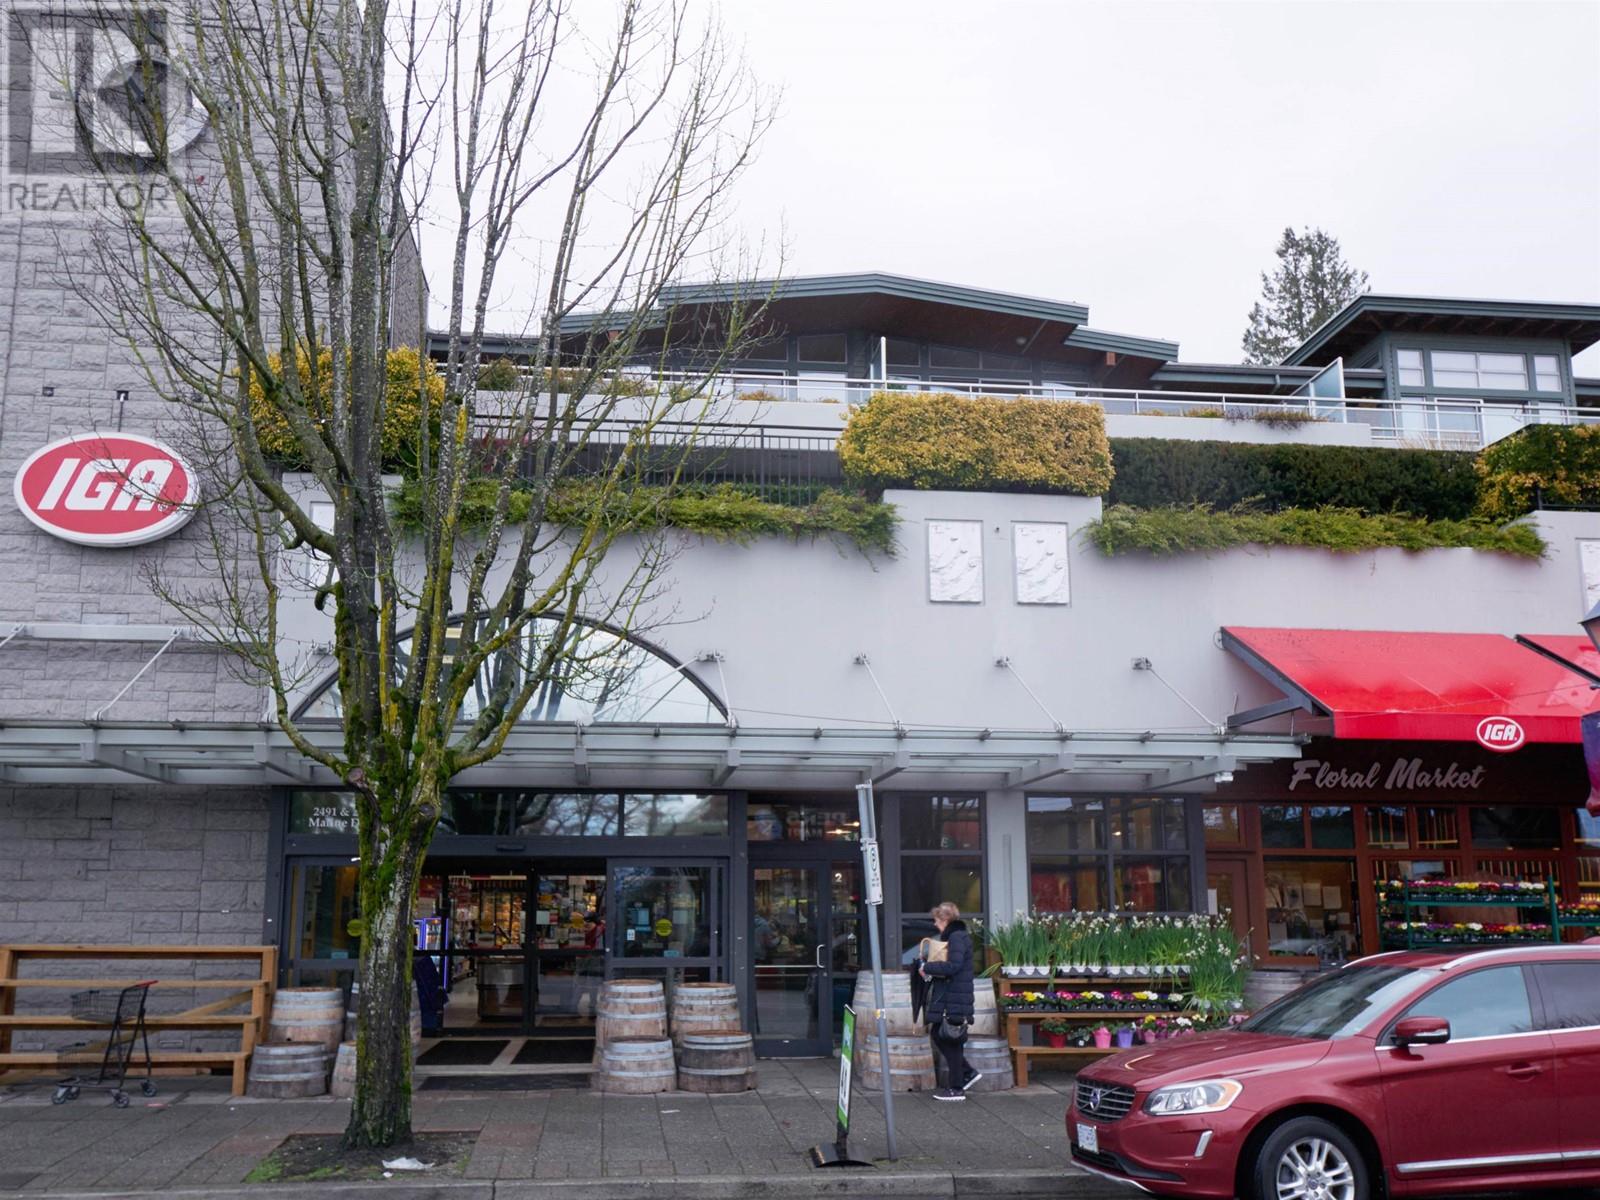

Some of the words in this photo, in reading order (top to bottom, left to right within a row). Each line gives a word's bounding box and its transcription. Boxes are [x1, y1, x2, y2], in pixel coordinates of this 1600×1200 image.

[37, 457, 174, 511] IGA
[1484, 724, 1516, 741] IGA
[1289, 759, 1381, 791] Floral
[1384, 757, 1486, 790] Market
[313, 807, 337, 817] 2491
[340, 807, 350, 817] &
[308, 817, 348, 828] Marine
[834, 872, 843, 882] 2
